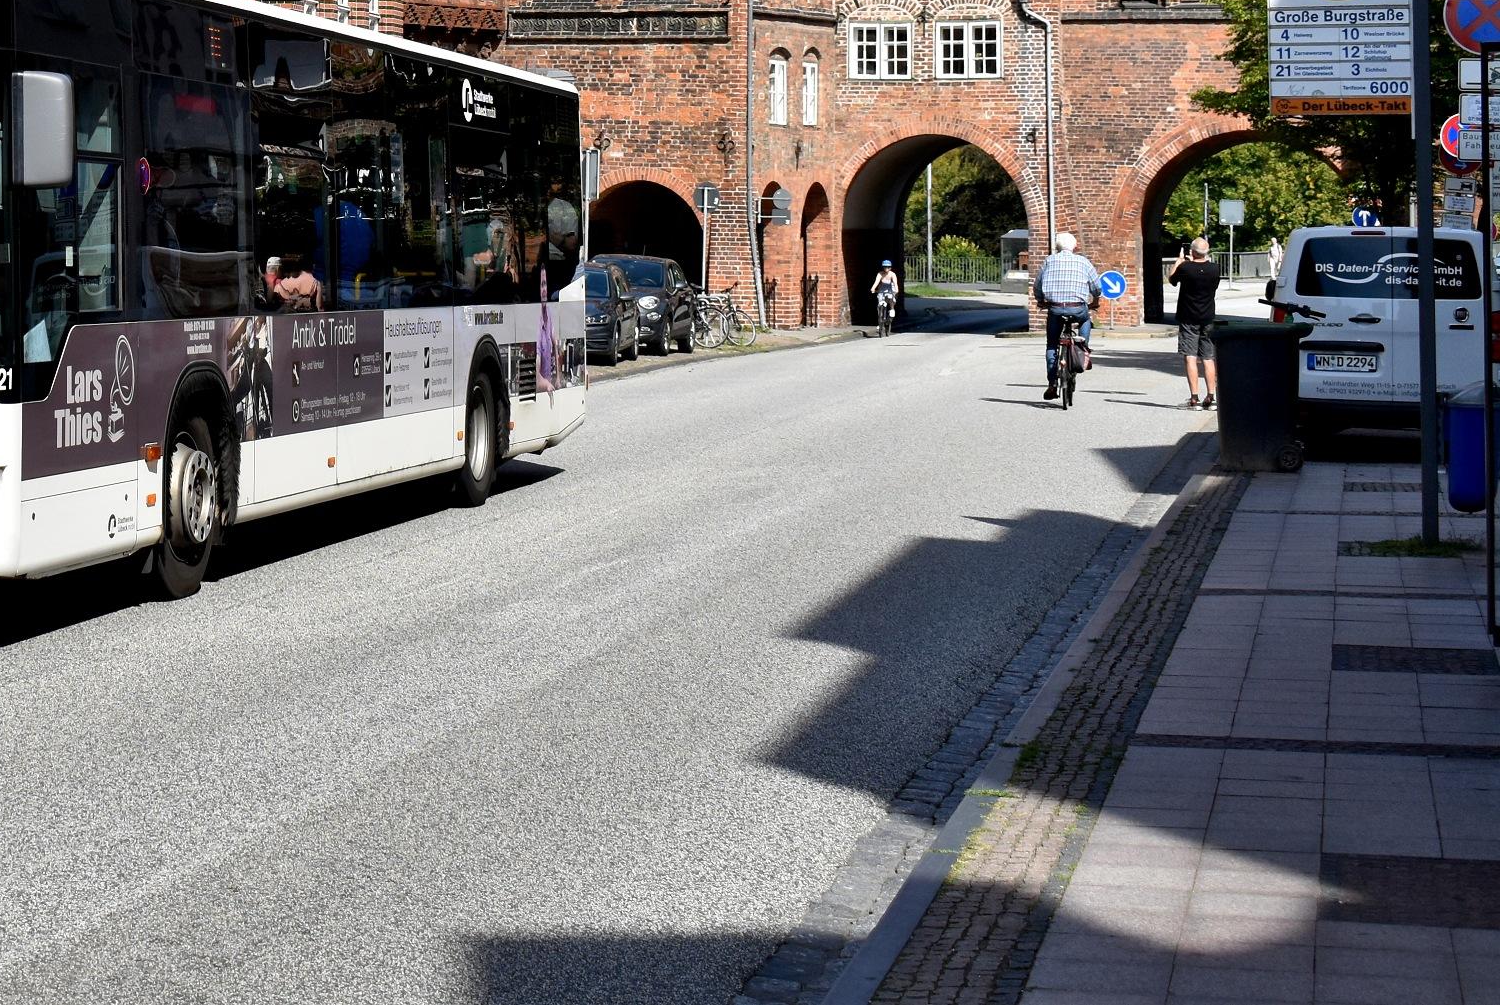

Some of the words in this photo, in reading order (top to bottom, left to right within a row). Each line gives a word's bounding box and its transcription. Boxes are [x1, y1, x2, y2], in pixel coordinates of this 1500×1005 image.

[1274, 10, 1319, 23] Große
[1323, 9, 1404, 24] Burgstraße
[1281, 29, 1290, 41] 4
[1341, 27, 1359, 40] 10
[1276, 47, 1291, 59] 11
[1341, 46, 1360, 59] 12
[1275, 65, 1291, 77] 21
[1351, 63, 1360, 76] 3
[1370, 81, 1409, 94] 6000
[1302, 101, 1324, 111] Der
[1326, 100, 1407, 111] Lübeck-Takt
[1315, 264, 1334, 273] DIS
[1338, 263, 1419, 274] Daten-IT-Servic
[1385, 277, 1462, 287] dis-da-it.de
[292, 319, 317, 349] Antik
[318, 319, 327, 347] &
[328, 317, 357, 346] Trödel
[1315, 356, 1330, 366] WN
[1336, 357, 1344, 367] D
[1346, 357, 1374, 368] 2294
[66, 365, 103, 405] Lars
[54, 406, 103, 449] Thies
